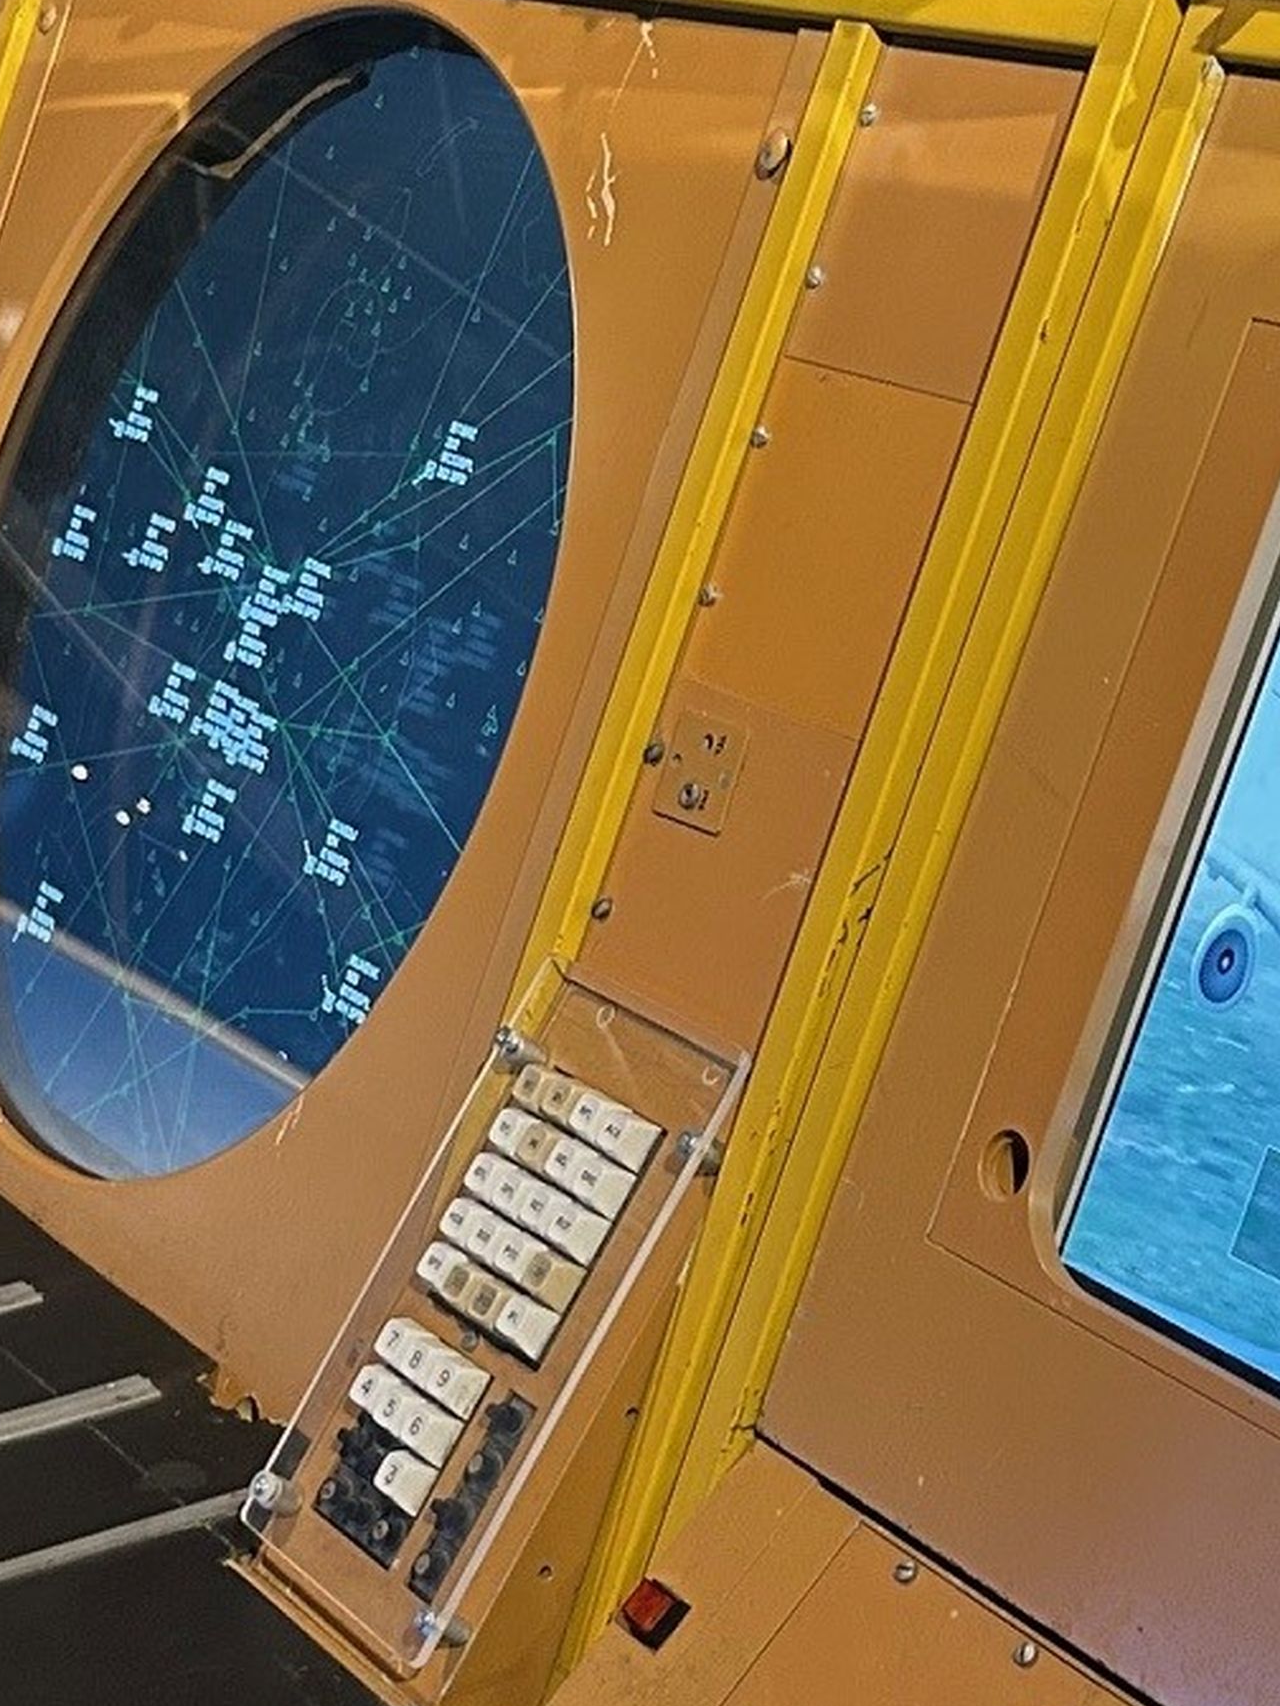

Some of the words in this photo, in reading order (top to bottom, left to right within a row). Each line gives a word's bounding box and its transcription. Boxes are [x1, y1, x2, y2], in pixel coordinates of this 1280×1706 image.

[408, 1350, 422, 1370] 8
[437, 1369, 451, 1387] 9
[410, 1416, 423, 1436] 6
